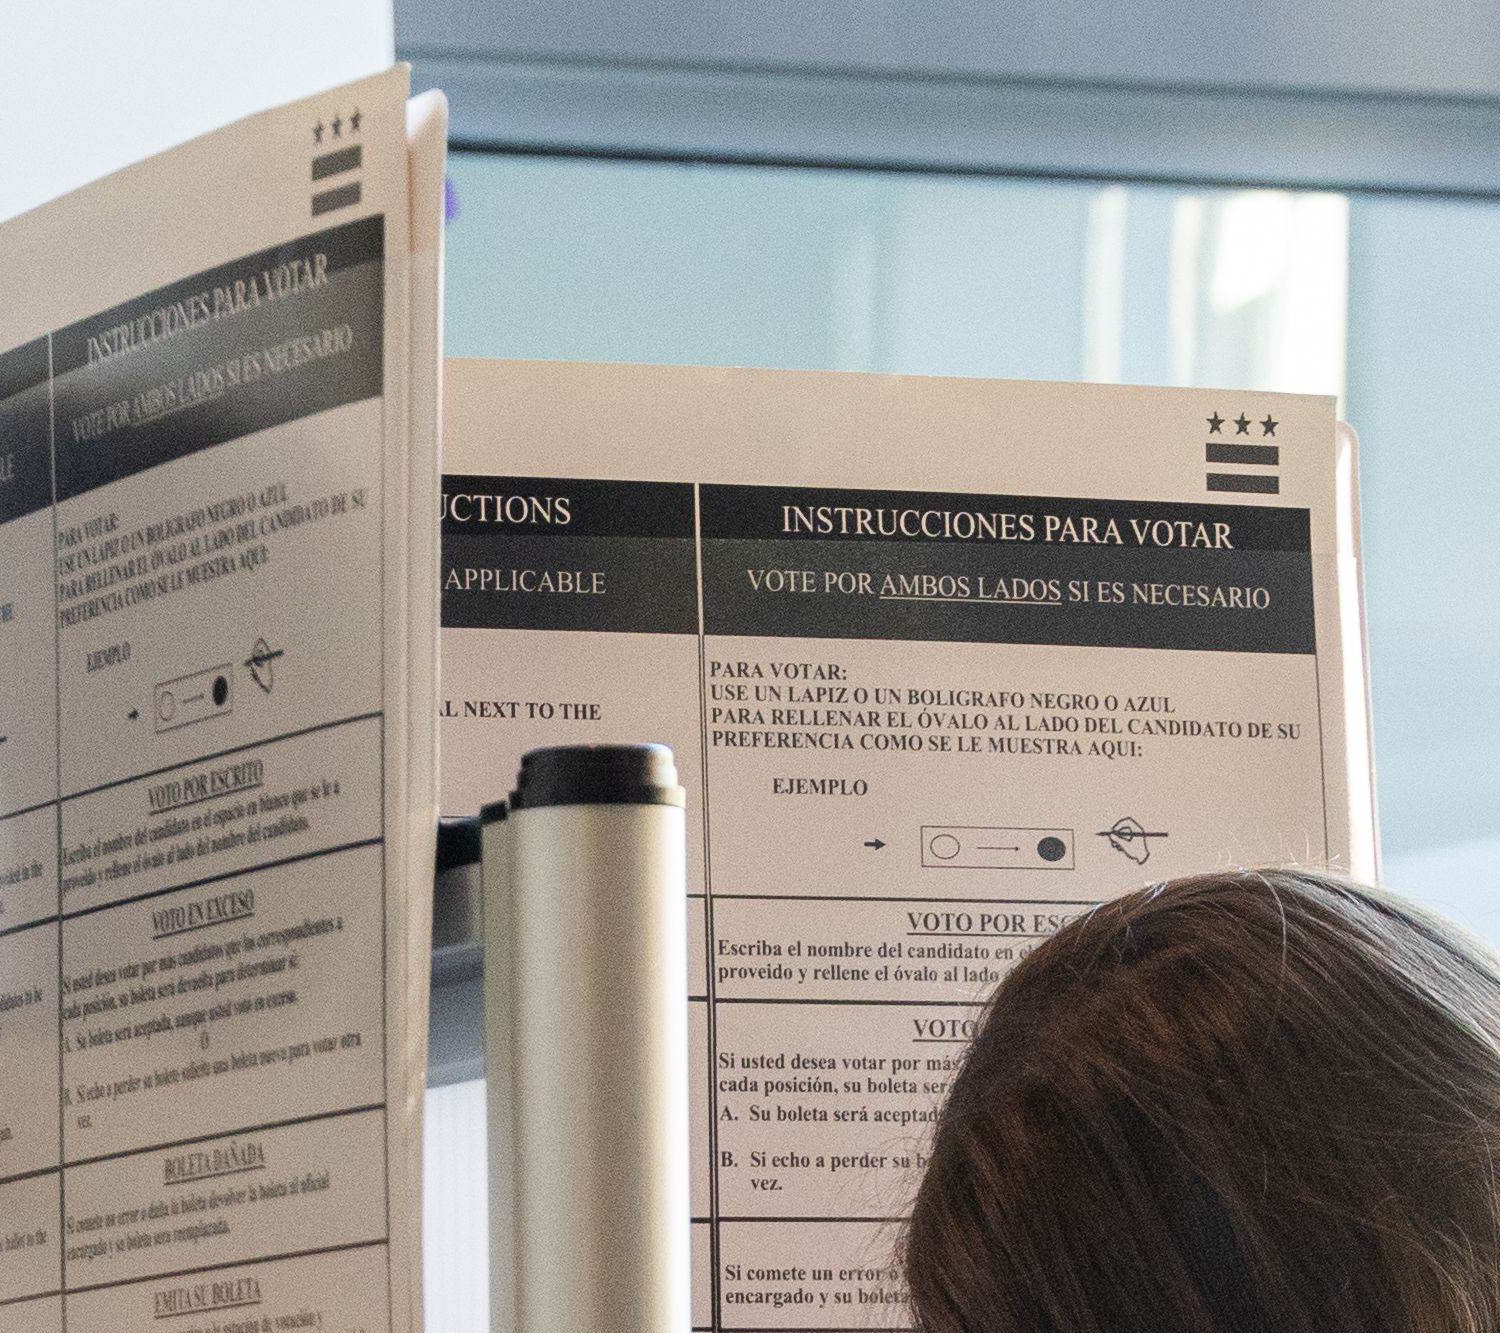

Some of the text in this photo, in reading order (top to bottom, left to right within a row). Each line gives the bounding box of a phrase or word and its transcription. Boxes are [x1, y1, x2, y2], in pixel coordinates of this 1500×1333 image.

[213, 277, 261, 321] PARA
[263, 253, 329, 301] VOTAR
[781, 504, 1233, 550] INSTRUCCIONES PARA VOTAR
[443, 567, 606, 595] APPLICABLE
[746, 567, 1271, 610] VOTE POR AMBOS LADOS SI ES NECESARIO
[709, 660, 847, 681] PARA VOTAR:
[709, 682, 1176, 714] USE UN LAPIZ O UN BOLIGRAFO NEGRO O AZUL
[463, 699, 601, 721] NEXT TO THE
[710, 706, 1300, 740] PARA RELLENAR EL ÓVALO AL LADO DEL CANDIDATO DE SU
[711, 728, 1143, 760] PREFERENCIA COMO SE LE MUESTRA AQUI:
[772, 777, 869, 796] EJEMPLO
[906, 911, 1026, 933] VOTO POR
[717, 938, 1013, 960] Escriba el nombre del candidato en
[717, 962, 1000, 984] proveido y rellene el óvalo al lado
[719, 1052, 921, 1075] Si usted desea votar por
[718, 1075, 918, 1098] cada posición, su boleta
[718, 1103, 869, 1123] A. Su boleta será
[720, 1150, 739, 1168] B.
[749, 1150, 767, 1168] Si
[771, 1151, 811, 1169] echo
[815, 1155, 826, 1169] a
[830, 1152, 888, 1173] perder
[749, 1177, 783, 1191] vez.
[723, 1263, 881, 1282] Si comete un error
[724, 1287, 852, 1309] encargado y su
